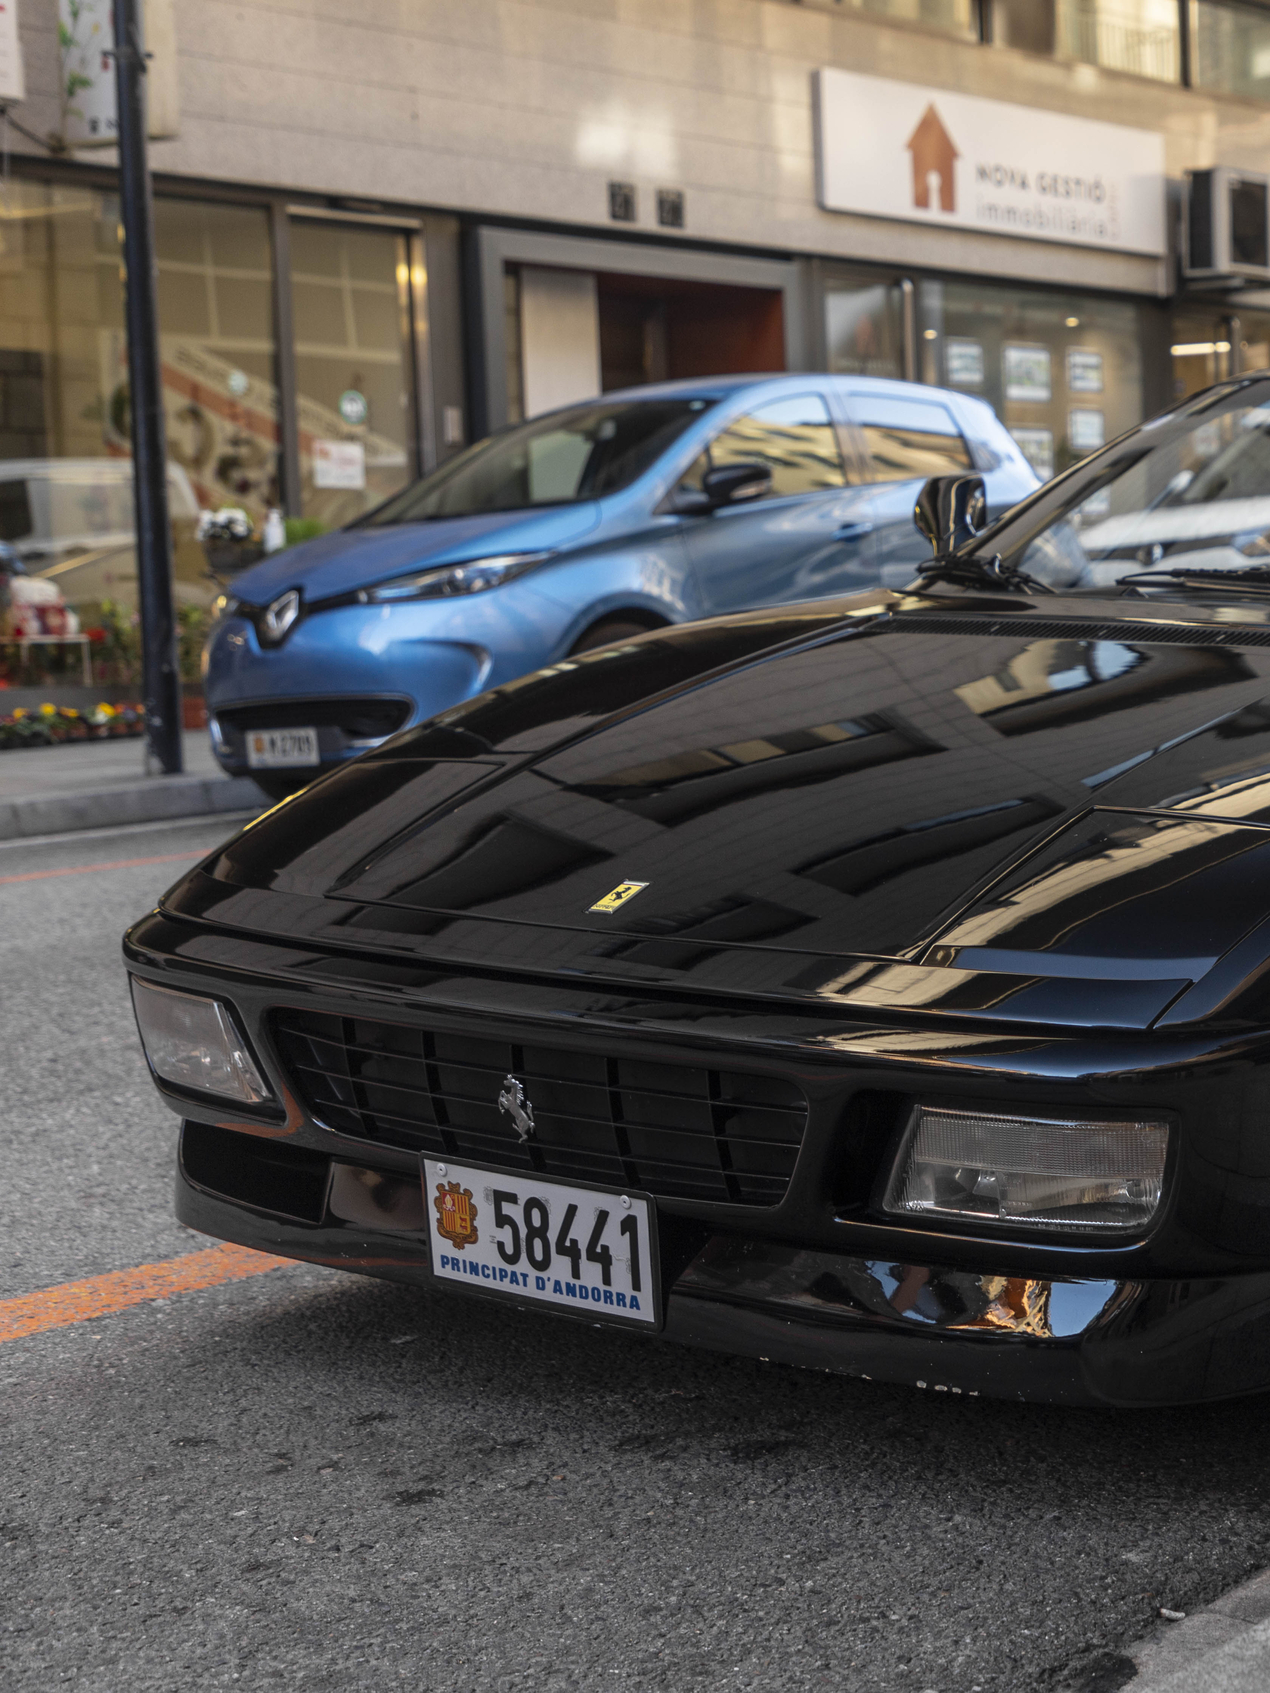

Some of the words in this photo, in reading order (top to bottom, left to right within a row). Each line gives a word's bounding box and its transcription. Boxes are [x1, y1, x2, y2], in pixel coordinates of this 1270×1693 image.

[976, 163, 1031, 191] NOVA
[493, 1189, 642, 1292] 58441
[440, 1254, 529, 1288] PRINCIPAT
[535, 1276, 641, 1311] D'ANDORRA
